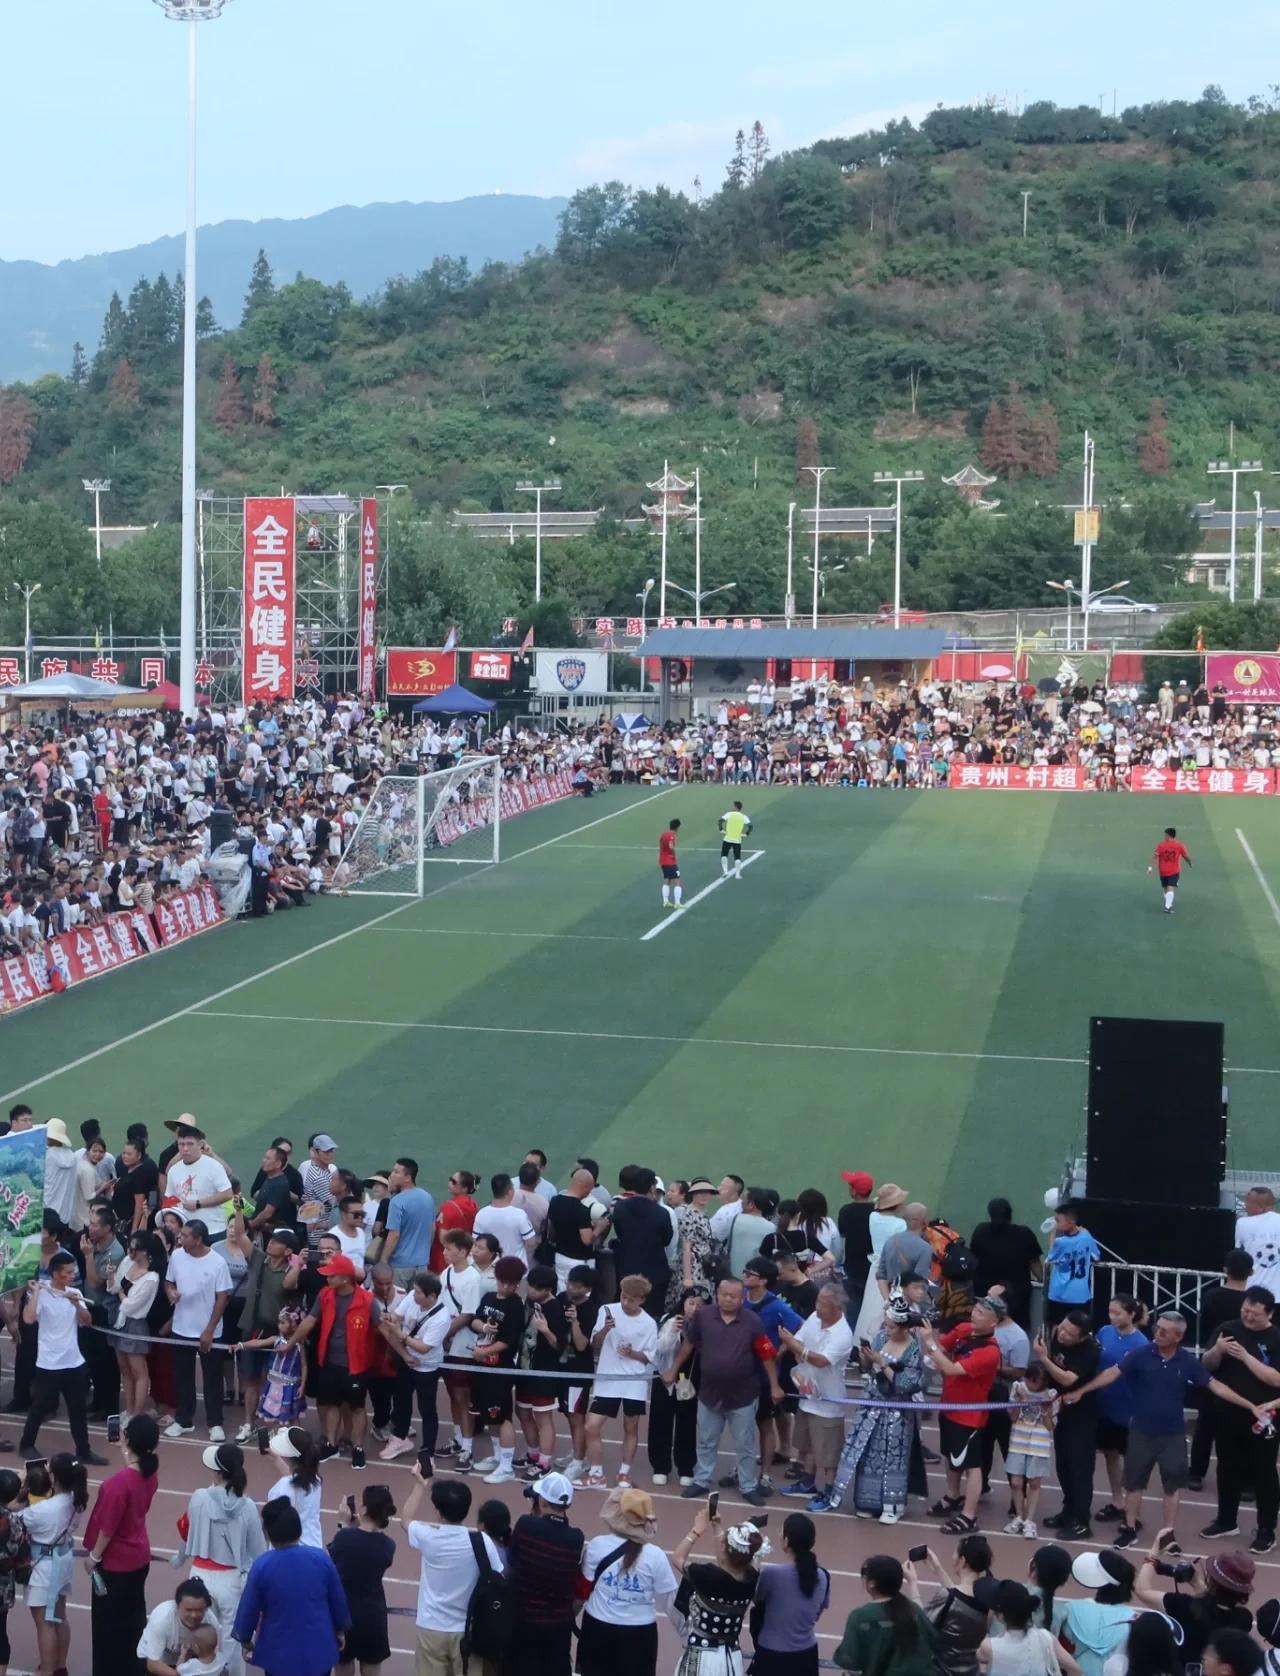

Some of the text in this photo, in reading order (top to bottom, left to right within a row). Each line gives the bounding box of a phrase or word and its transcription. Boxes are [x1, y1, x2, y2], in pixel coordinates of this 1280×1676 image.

[249, 515, 288, 692] 全民健身
[473, 663, 507, 678] 安全出口
[670, 660, 681, 684] 3
[959, 766, 1078, 788] 贵州·村超
[1140, 770, 1270, 793] 全民健身
